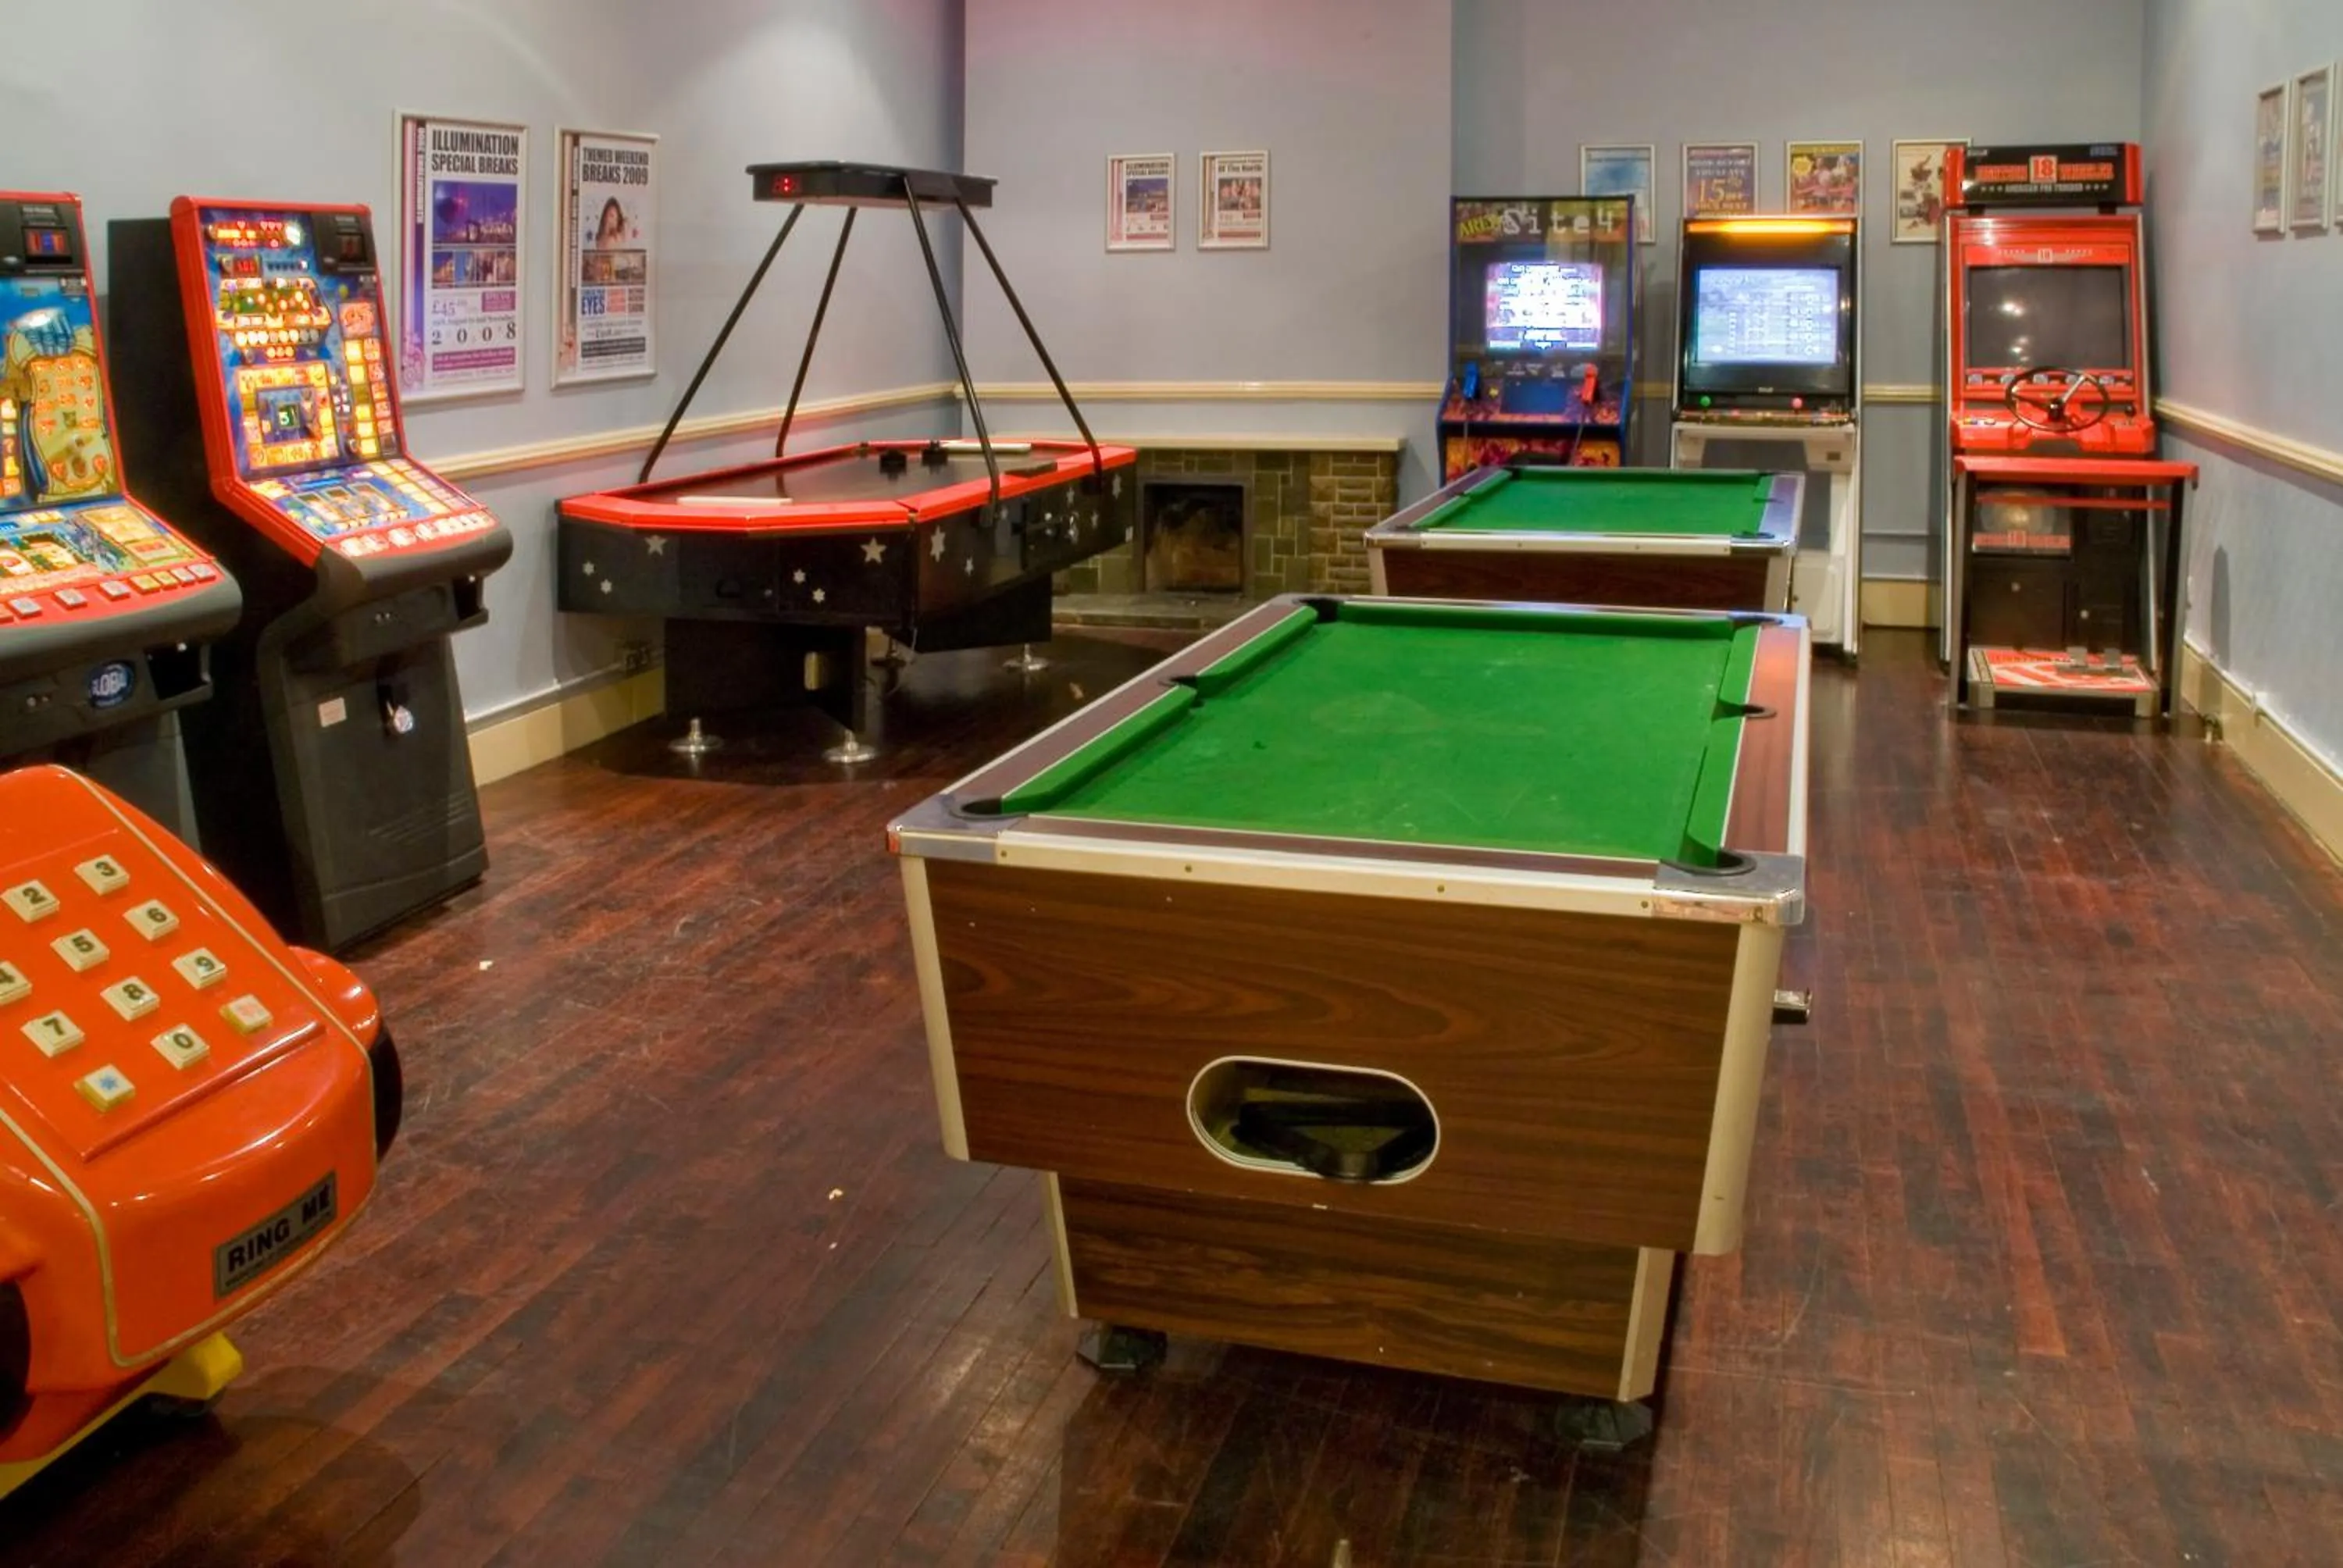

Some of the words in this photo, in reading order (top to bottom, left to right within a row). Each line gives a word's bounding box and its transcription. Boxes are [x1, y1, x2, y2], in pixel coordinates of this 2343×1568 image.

[433, 130, 519, 156] ILLUMINATION
[432, 154, 476, 173] SPECIAL
[478, 155, 518, 176] BREAKS
[583, 148, 613, 163] THEMED
[615, 149, 649, 166] WEEKEND
[583, 163, 621, 184] BREAKS
[622, 166, 648, 186] 2009
[2034, 158, 2054, 180] 18
[582, 295, 604, 315] EYES
[95, 861, 116, 876] 3
[22, 887, 47, 904] 2
[147, 907, 167, 922] 6
[72, 935, 95, 953] 5
[195, 956, 216, 972] 9
[123, 984, 145, 1000] 8
[43, 1017, 64, 1035] 7
[173, 1033, 194, 1049] 0
[228, 1217, 291, 1273] RING
[301, 1183, 330, 1225] ME
